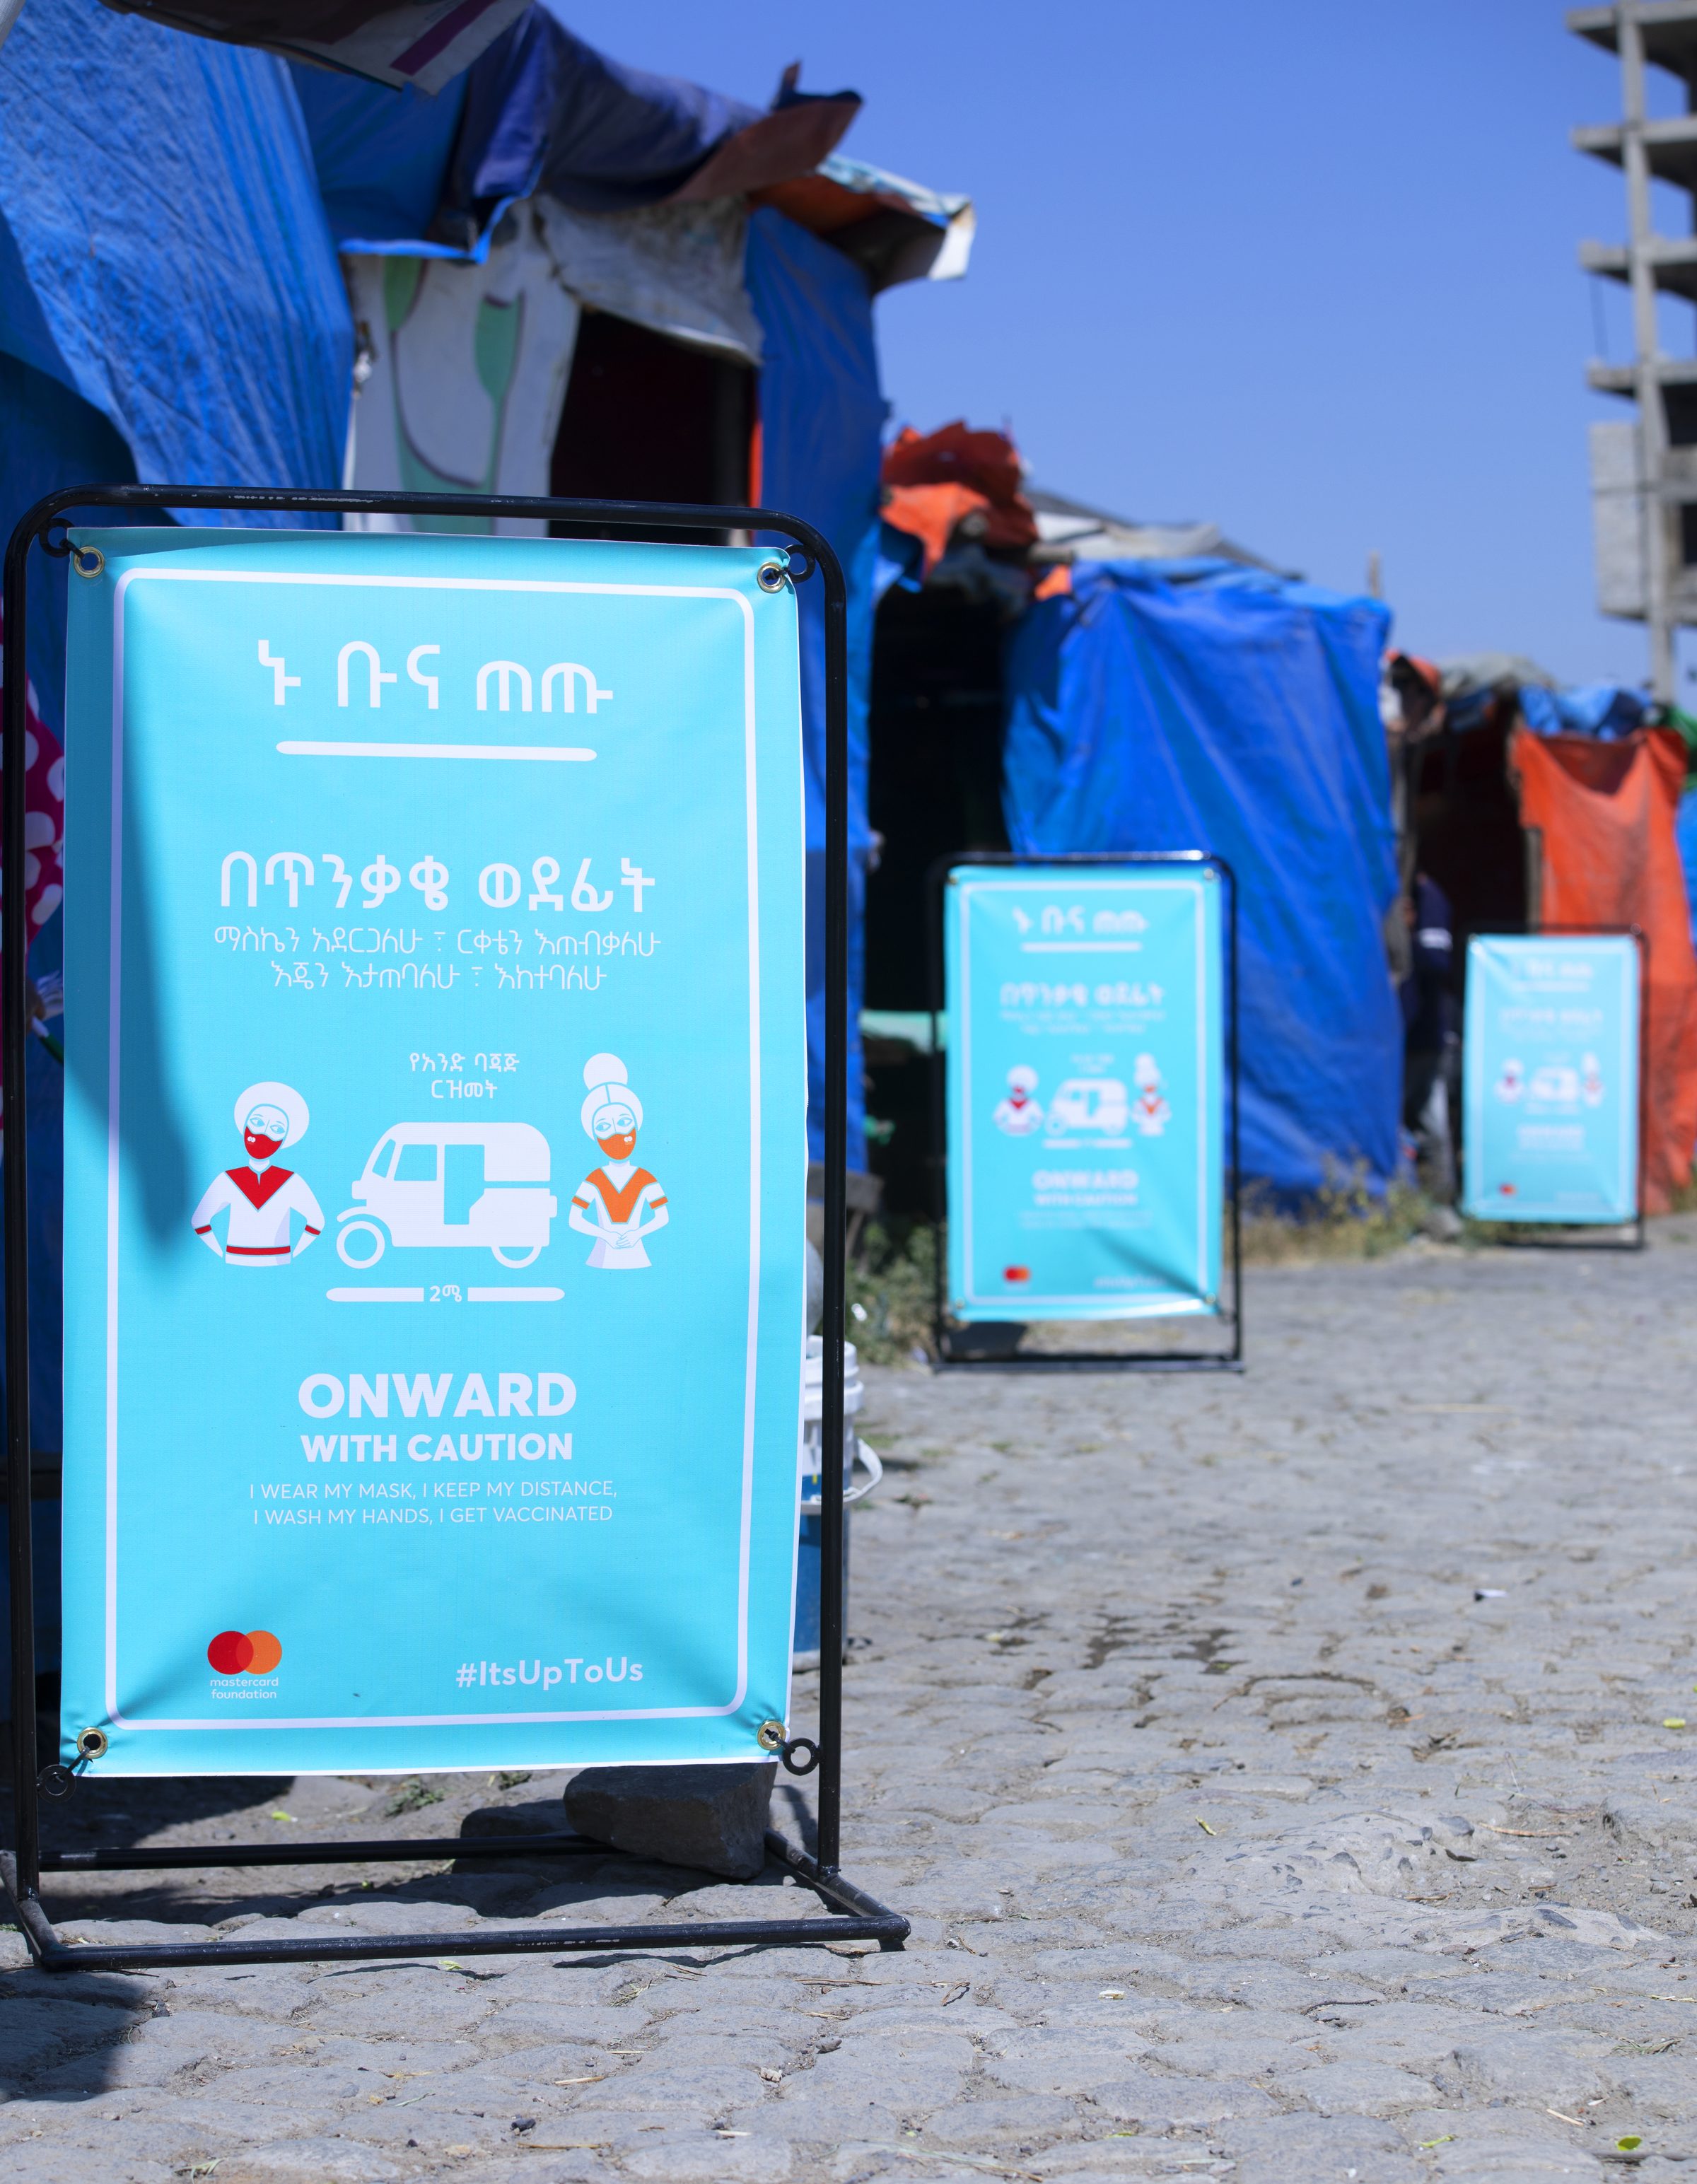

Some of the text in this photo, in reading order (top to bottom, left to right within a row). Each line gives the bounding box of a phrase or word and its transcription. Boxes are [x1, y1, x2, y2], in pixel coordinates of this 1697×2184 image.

[258, 640, 614, 714] ኑ ቡና ጠጡ
[221, 851, 656, 913] በጥንቃቄ ወደፊት
[214, 926, 301, 952] ማስኬን
[313, 927, 424, 954] አደርጋለሁ
[457, 929, 523, 955] ርቀቴን
[535, 929, 662, 957] እጠብቃለሁ
[271, 960, 330, 990] እጄን
[341, 961, 461, 990] እታጠባለሁ
[495, 963, 608, 991] እከተባለሁ
[409, 1052, 520, 1073] የአንድ ባጃጅ
[431, 1080, 498, 1099] ርዝመት
[429, 1284, 462, 1302] 2ሜ
[299, 1373, 578, 1418] ONWARD
[301, 1433, 573, 1464] WITH CAUTION
[250, 1481, 617, 1501] I WEAR MY MASK, I KEEP MY DISTANCE,
[254, 1506, 613, 1526] I WASH MY HANDS, I GET VACCINATED
[210, 1676, 279, 1688] mastercard
[455, 1657, 644, 1691] #ItsUpToUs
[211, 1688, 278, 1700] foundation
